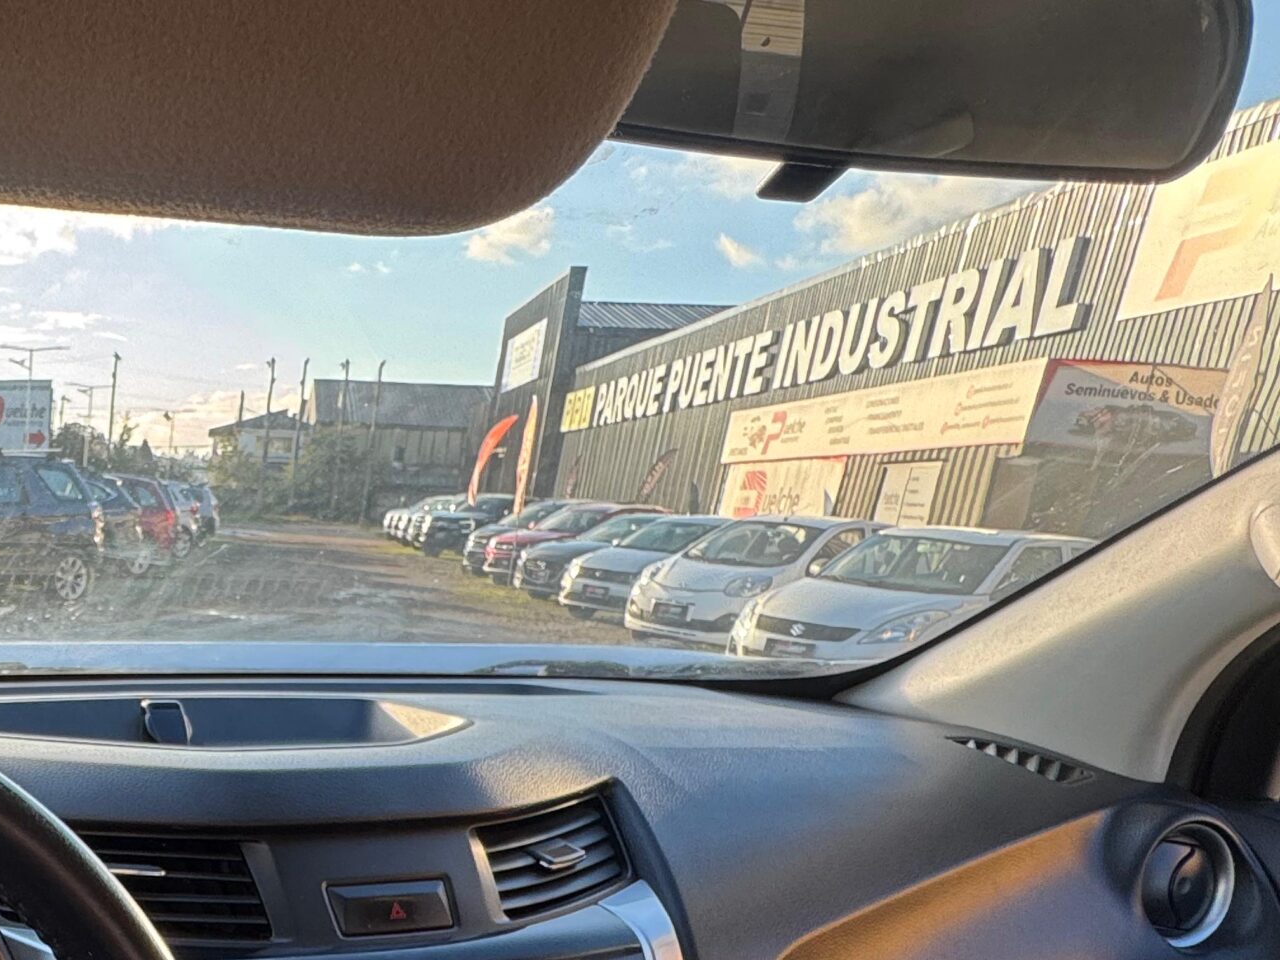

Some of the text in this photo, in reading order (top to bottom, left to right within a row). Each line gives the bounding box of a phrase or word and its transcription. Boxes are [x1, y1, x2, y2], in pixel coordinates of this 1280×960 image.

[593, 369, 664, 426] PARQUE
[665, 330, 775, 414] PUENTE
[773, 237, 1087, 389] INDUSTRIAL
[1128, 371, 1174, 388] Autos
[1065, 383, 1155, 402] Seminuevos
[1158, 390, 1169, 404] &
